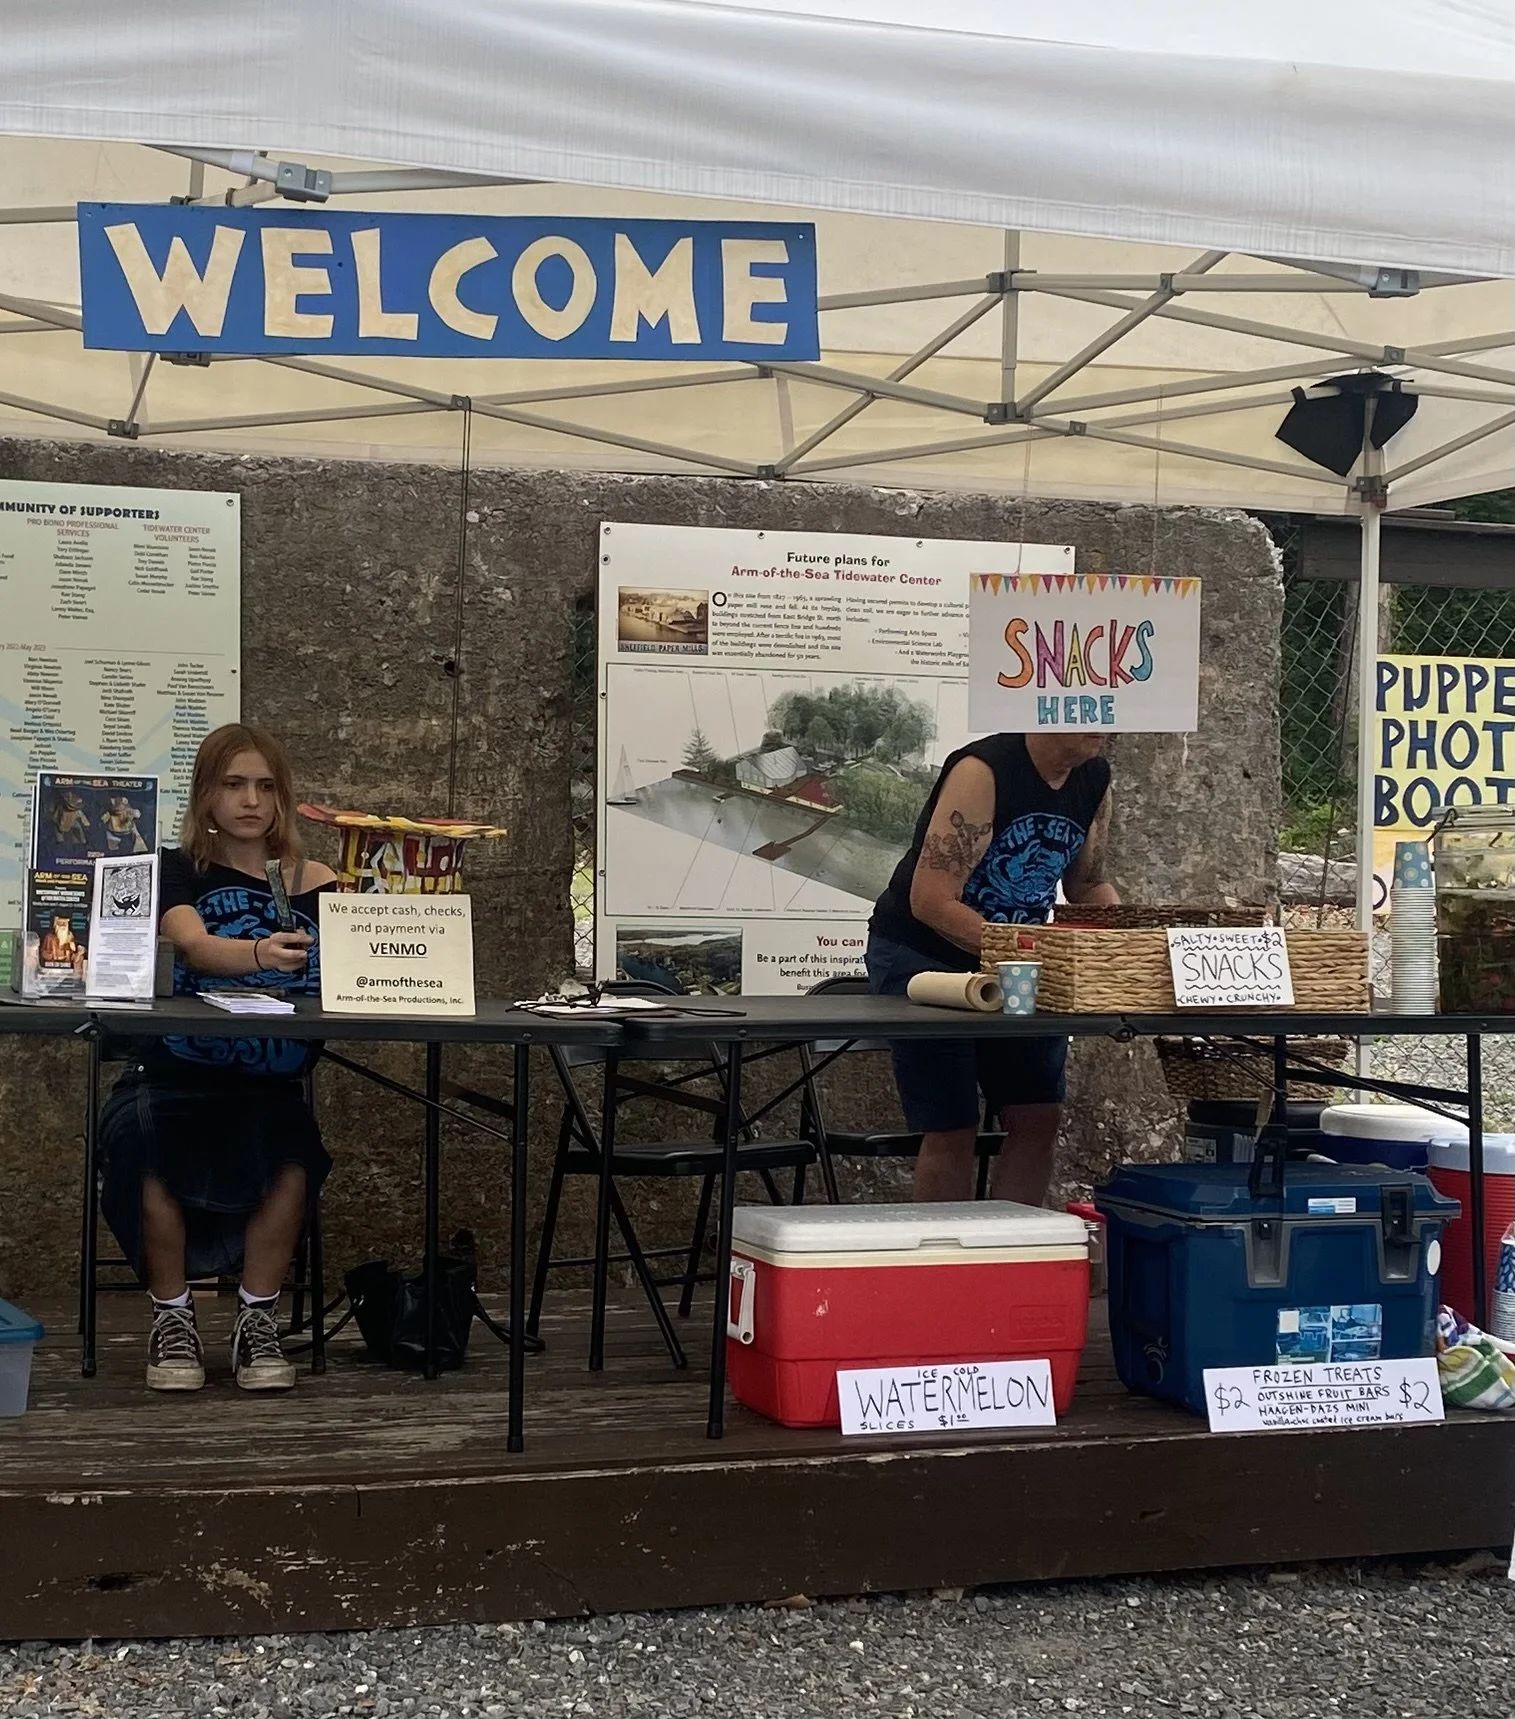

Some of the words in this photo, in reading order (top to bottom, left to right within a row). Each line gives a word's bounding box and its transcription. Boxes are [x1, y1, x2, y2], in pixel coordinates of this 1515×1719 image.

[103, 220, 789, 346] WELCOME
[59, 505, 77, 515] OF
[80, 506, 160, 520] SUPPORTERS
[27, 518, 42, 526] PRO
[43, 519, 65, 527] BONO
[66, 520, 119, 530] PROFESSIONAL
[143, 524, 182, 534] TIDEWATER
[184, 526, 211, 535] CENTER
[57, 529, 90, 537] SERVICES
[154, 534, 200, 543] VOLUNTEERS
[787, 552, 830, 565] Future
[834, 554, 868, 568] plans
[870, 555, 890, 568] for
[731, 565, 830, 581] Arm-of-the-Sea
[834, 569, 896, 583] Tidewater
[899, 573, 942, 586] Center
[658, 644, 679, 653] PAPER
[730, 641, 756, 649] buildings
[997, 617, 1155, 688] SNACKS
[1376, 661, 1515, 716] PUPPE
[1037, 695, 1115, 725] HERE
[1381, 719, 1515, 772] PHOT
[112, 780, 142, 788] THEATER
[1004, 817, 1035, 849] THE
[207, 890, 250, 916] THE
[328, 903, 348, 913] We
[351, 904, 389, 917] accept
[392, 905, 421, 917] cash,
[424, 905, 466, 918] checks,
[350, 923, 371, 933] and
[375, 924, 426, 935] payment
[428, 924, 445, 934] via
[816, 936, 838, 947] You
[842, 938, 864, 947] can
[1173, 933, 1212, 947] SALTY
[1219, 934, 1257, 944] SWEET
[1261, 930, 1284, 948] $2
[369, 942, 427, 956] VENMO
[757, 954, 769, 963] Be
[779, 955, 797, 965] part
[799, 954, 809, 964] of
[810, 955, 827, 964] this
[779, 968, 811, 978] benefit
[813, 968, 829, 978] this
[1182, 953, 1283, 981] SNACKS
[356, 976, 443, 988] @armofthesea
[336, 994, 397, 1003] Arm-of-the-Sea
[399, 995, 448, 1005] Productions,
[1180, 994, 1216, 1004] CHEWY
[1226, 993, 1276, 1003] CRUNCHY
[918, 1369, 938, 1378] ICE
[953, 1366, 979, 1376] COLD
[1253, 1369, 1313, 1384] FROZEN
[1324, 1367, 1382, 1381] TREATS
[855, 1374, 1049, 1418] WATERMELON
[1214, 1382, 1250, 1415] $2
[1257, 1389, 1313, 1402] OUTSHINE
[1317, 1388, 1352, 1400] FRUIT
[1360, 1385, 1390, 1399] BARS
[1400, 1377, 1432, 1413] $2
[1346, 1402, 1369, 1411] MINI
[860, 1420, 915, 1430] SLICES
[1341, 1415, 1353, 1424] ice
[1357, 1414, 1382, 1422] cream
